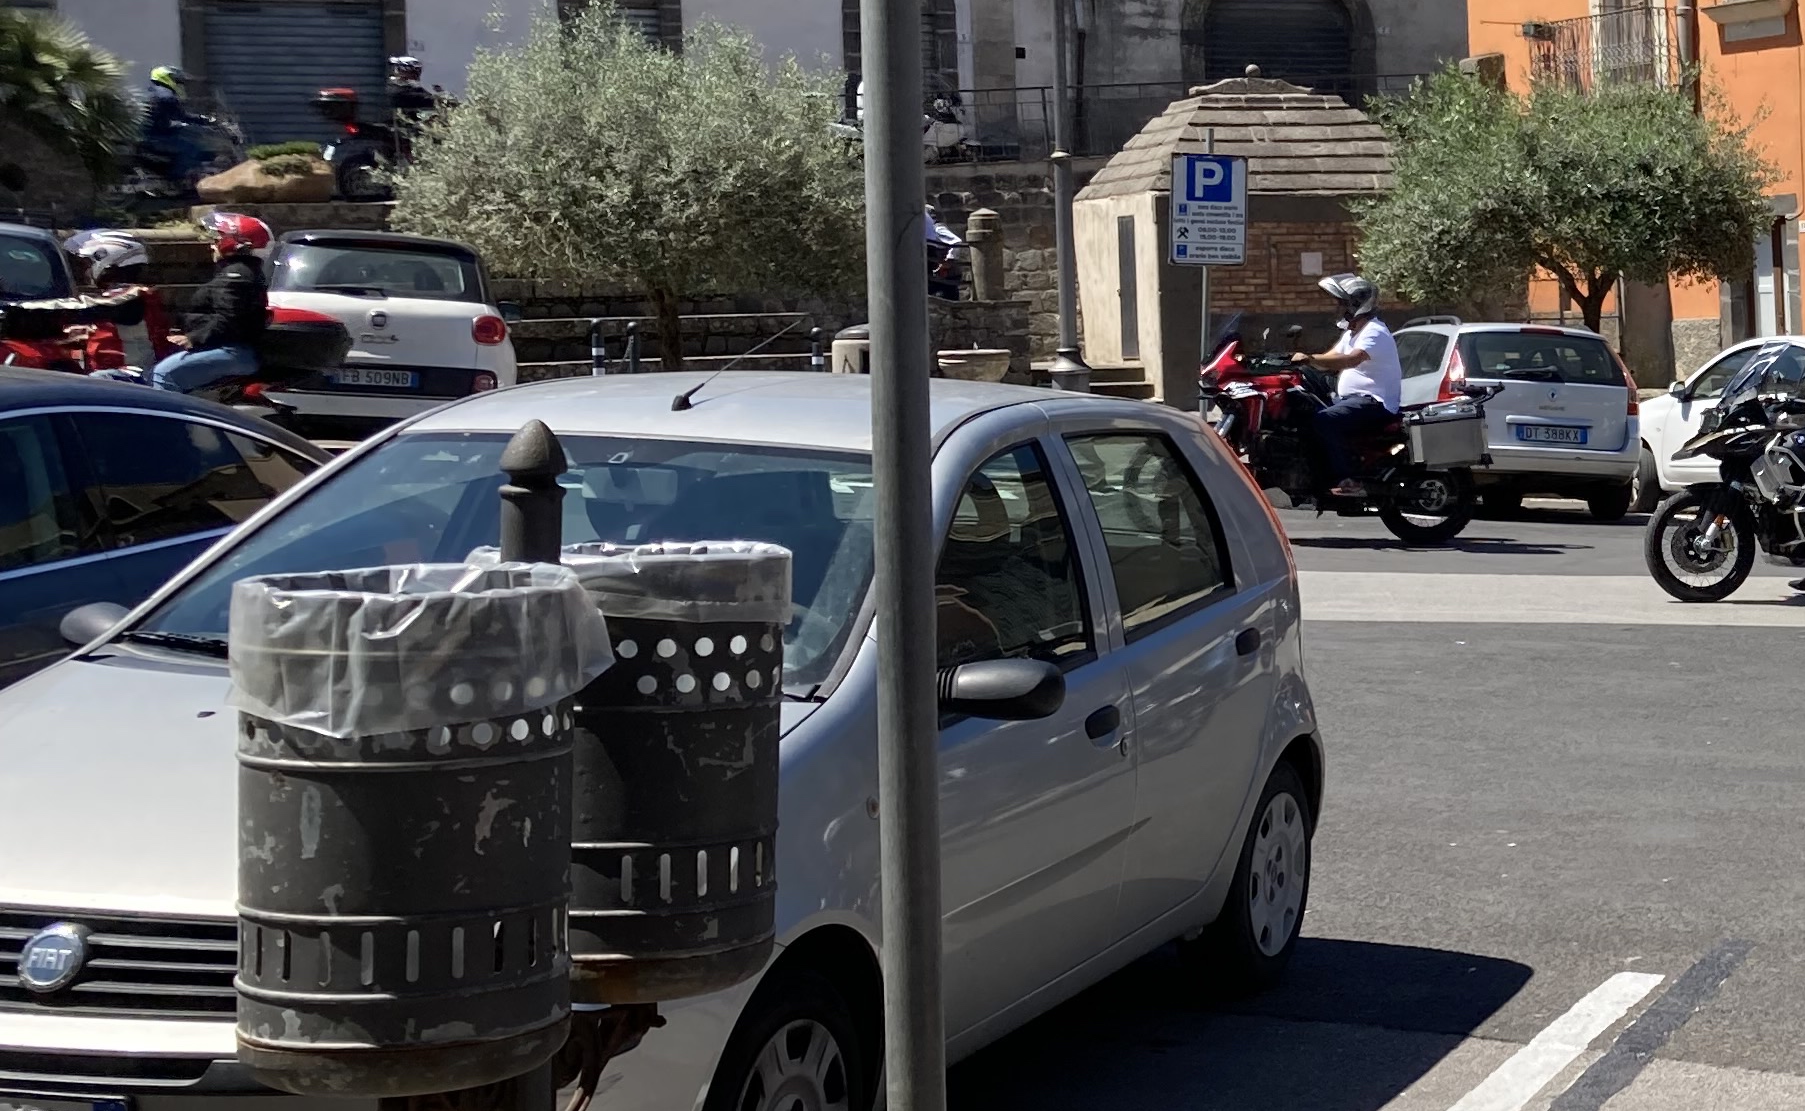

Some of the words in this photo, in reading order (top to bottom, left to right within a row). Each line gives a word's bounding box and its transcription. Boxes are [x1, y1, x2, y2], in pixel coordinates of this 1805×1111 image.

[1194, 161, 1224, 198] P
[365, 371, 409, 385] 509NB
[1525, 427, 1539, 439] DT
[1544, 428, 1579, 441] 388KX
[27, 947, 73, 970] FIAT
